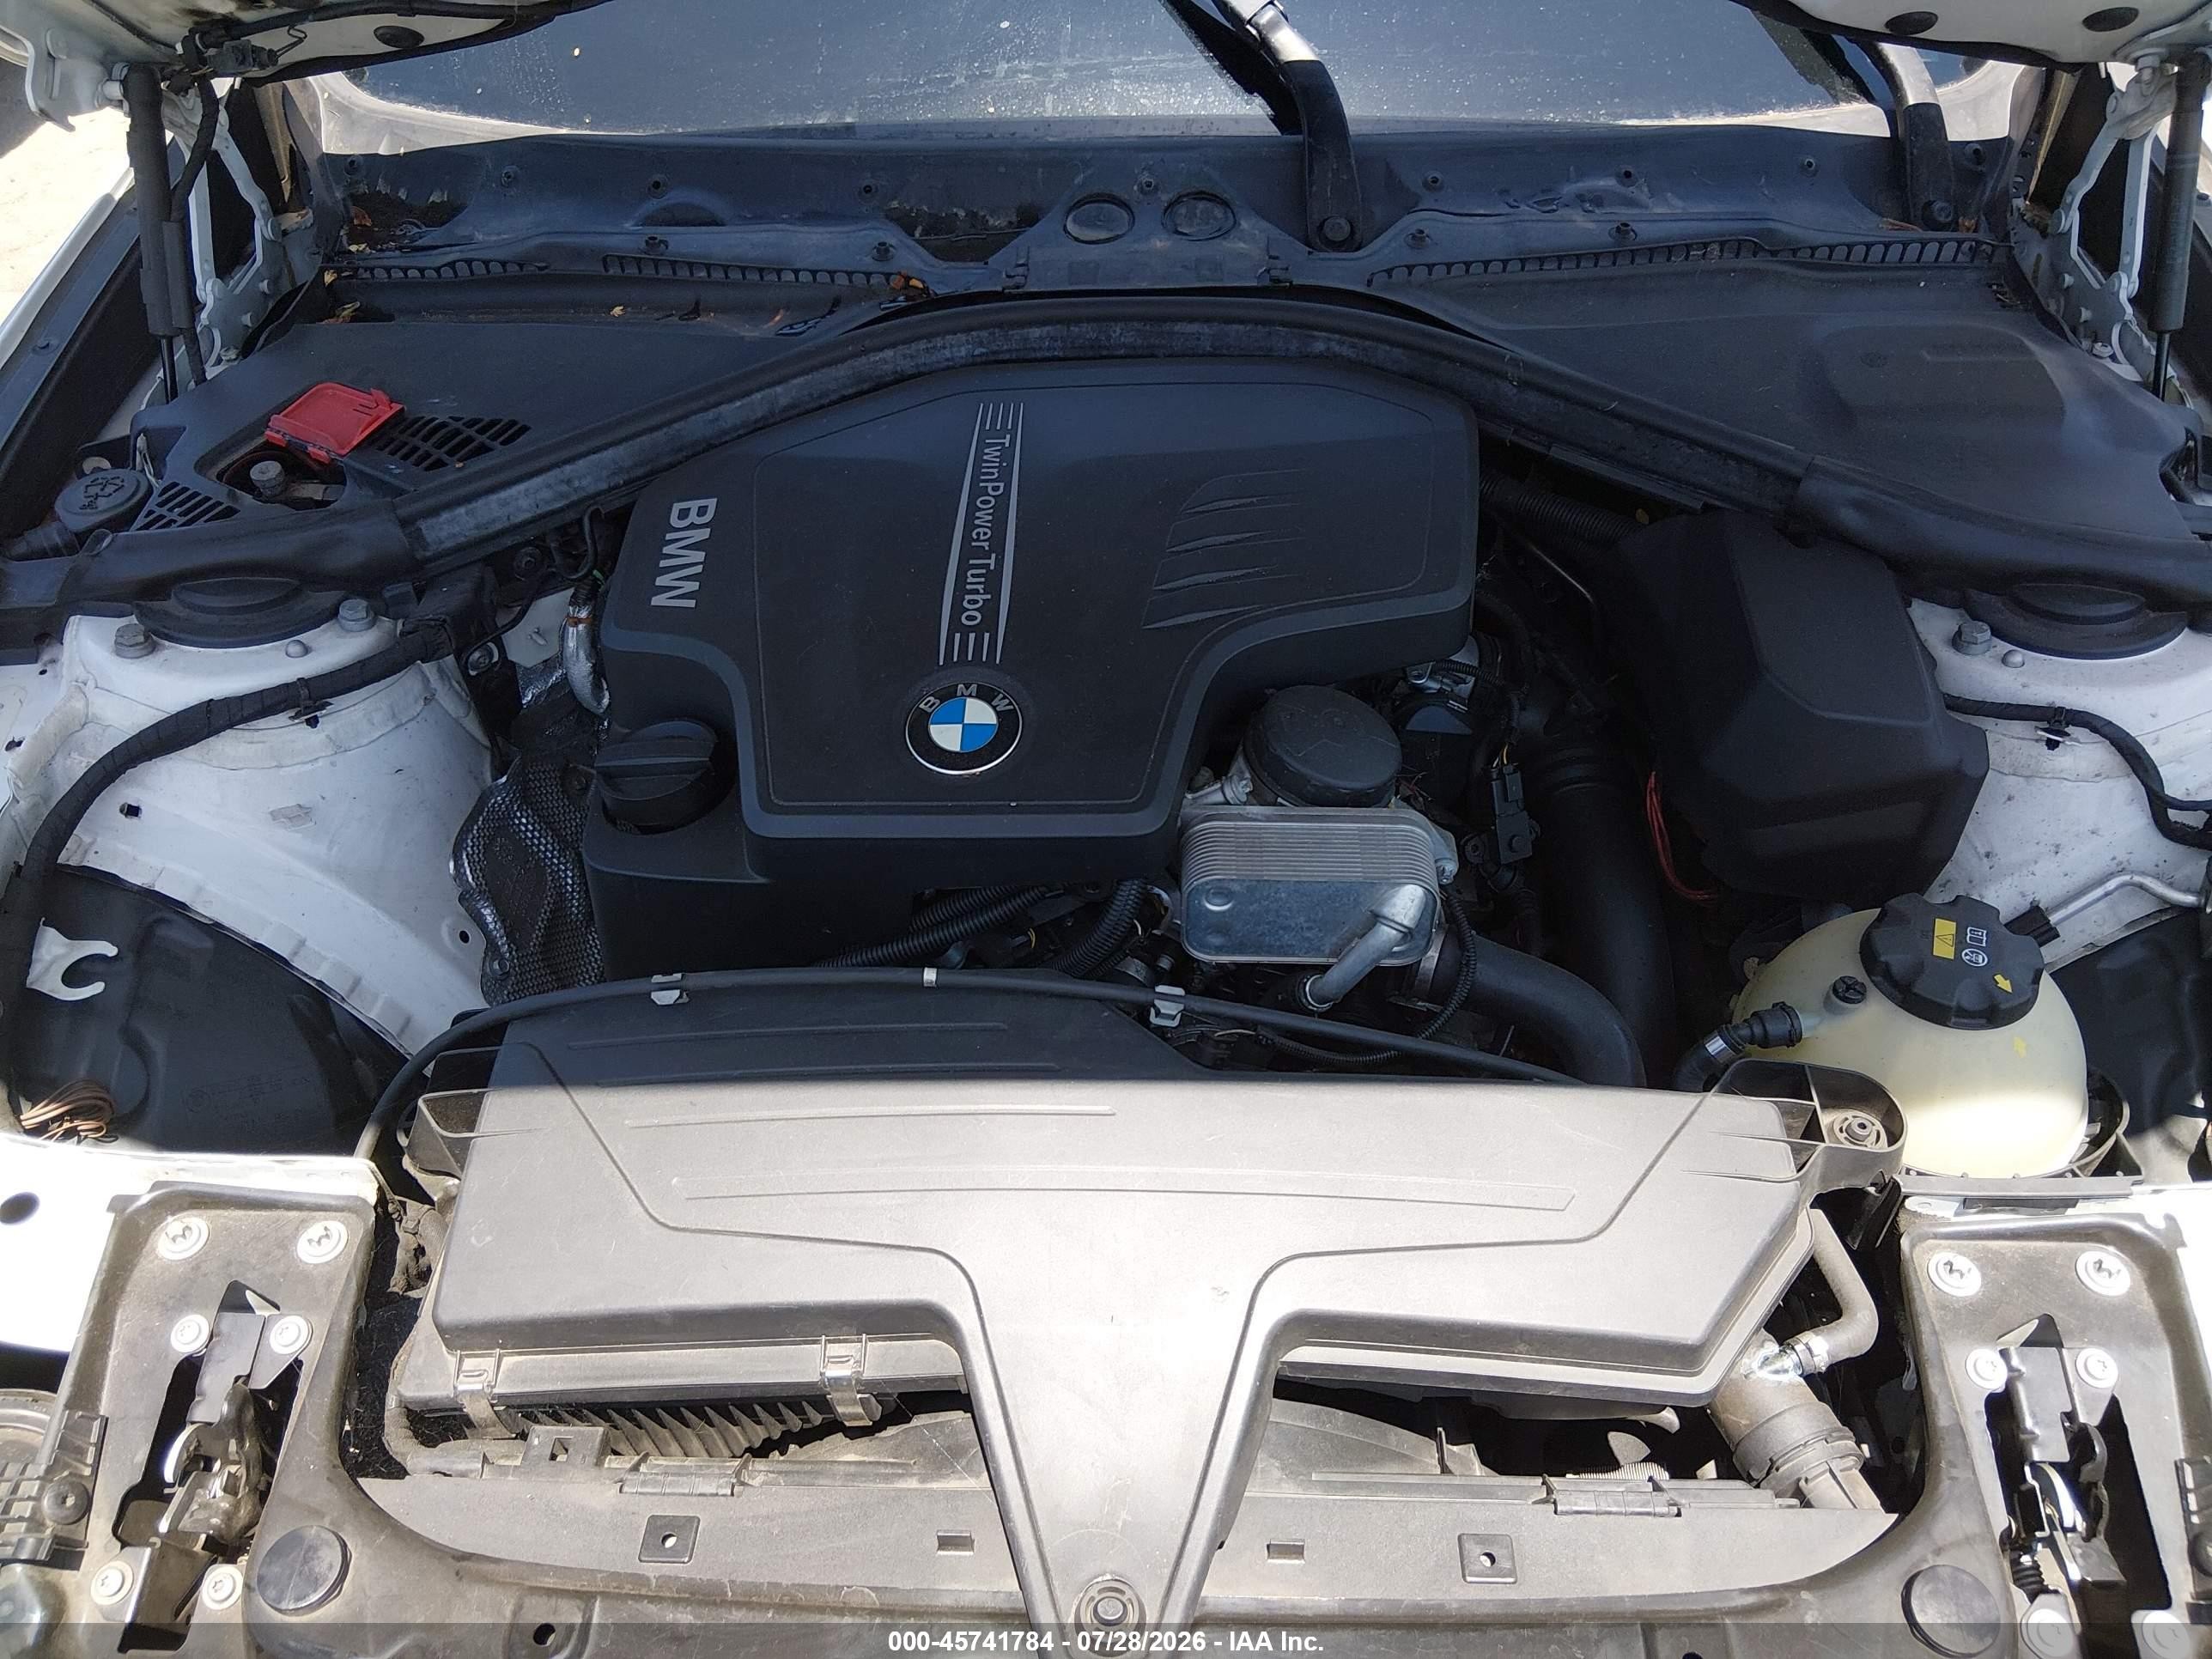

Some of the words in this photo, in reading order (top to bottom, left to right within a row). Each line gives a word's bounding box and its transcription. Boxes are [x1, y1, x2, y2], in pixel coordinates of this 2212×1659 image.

[971, 434, 1011, 550] TwinPower
[650, 498, 718, 608] BMW
[960, 553, 996, 626] Turbo
[918, 684, 1015, 714] BMW
